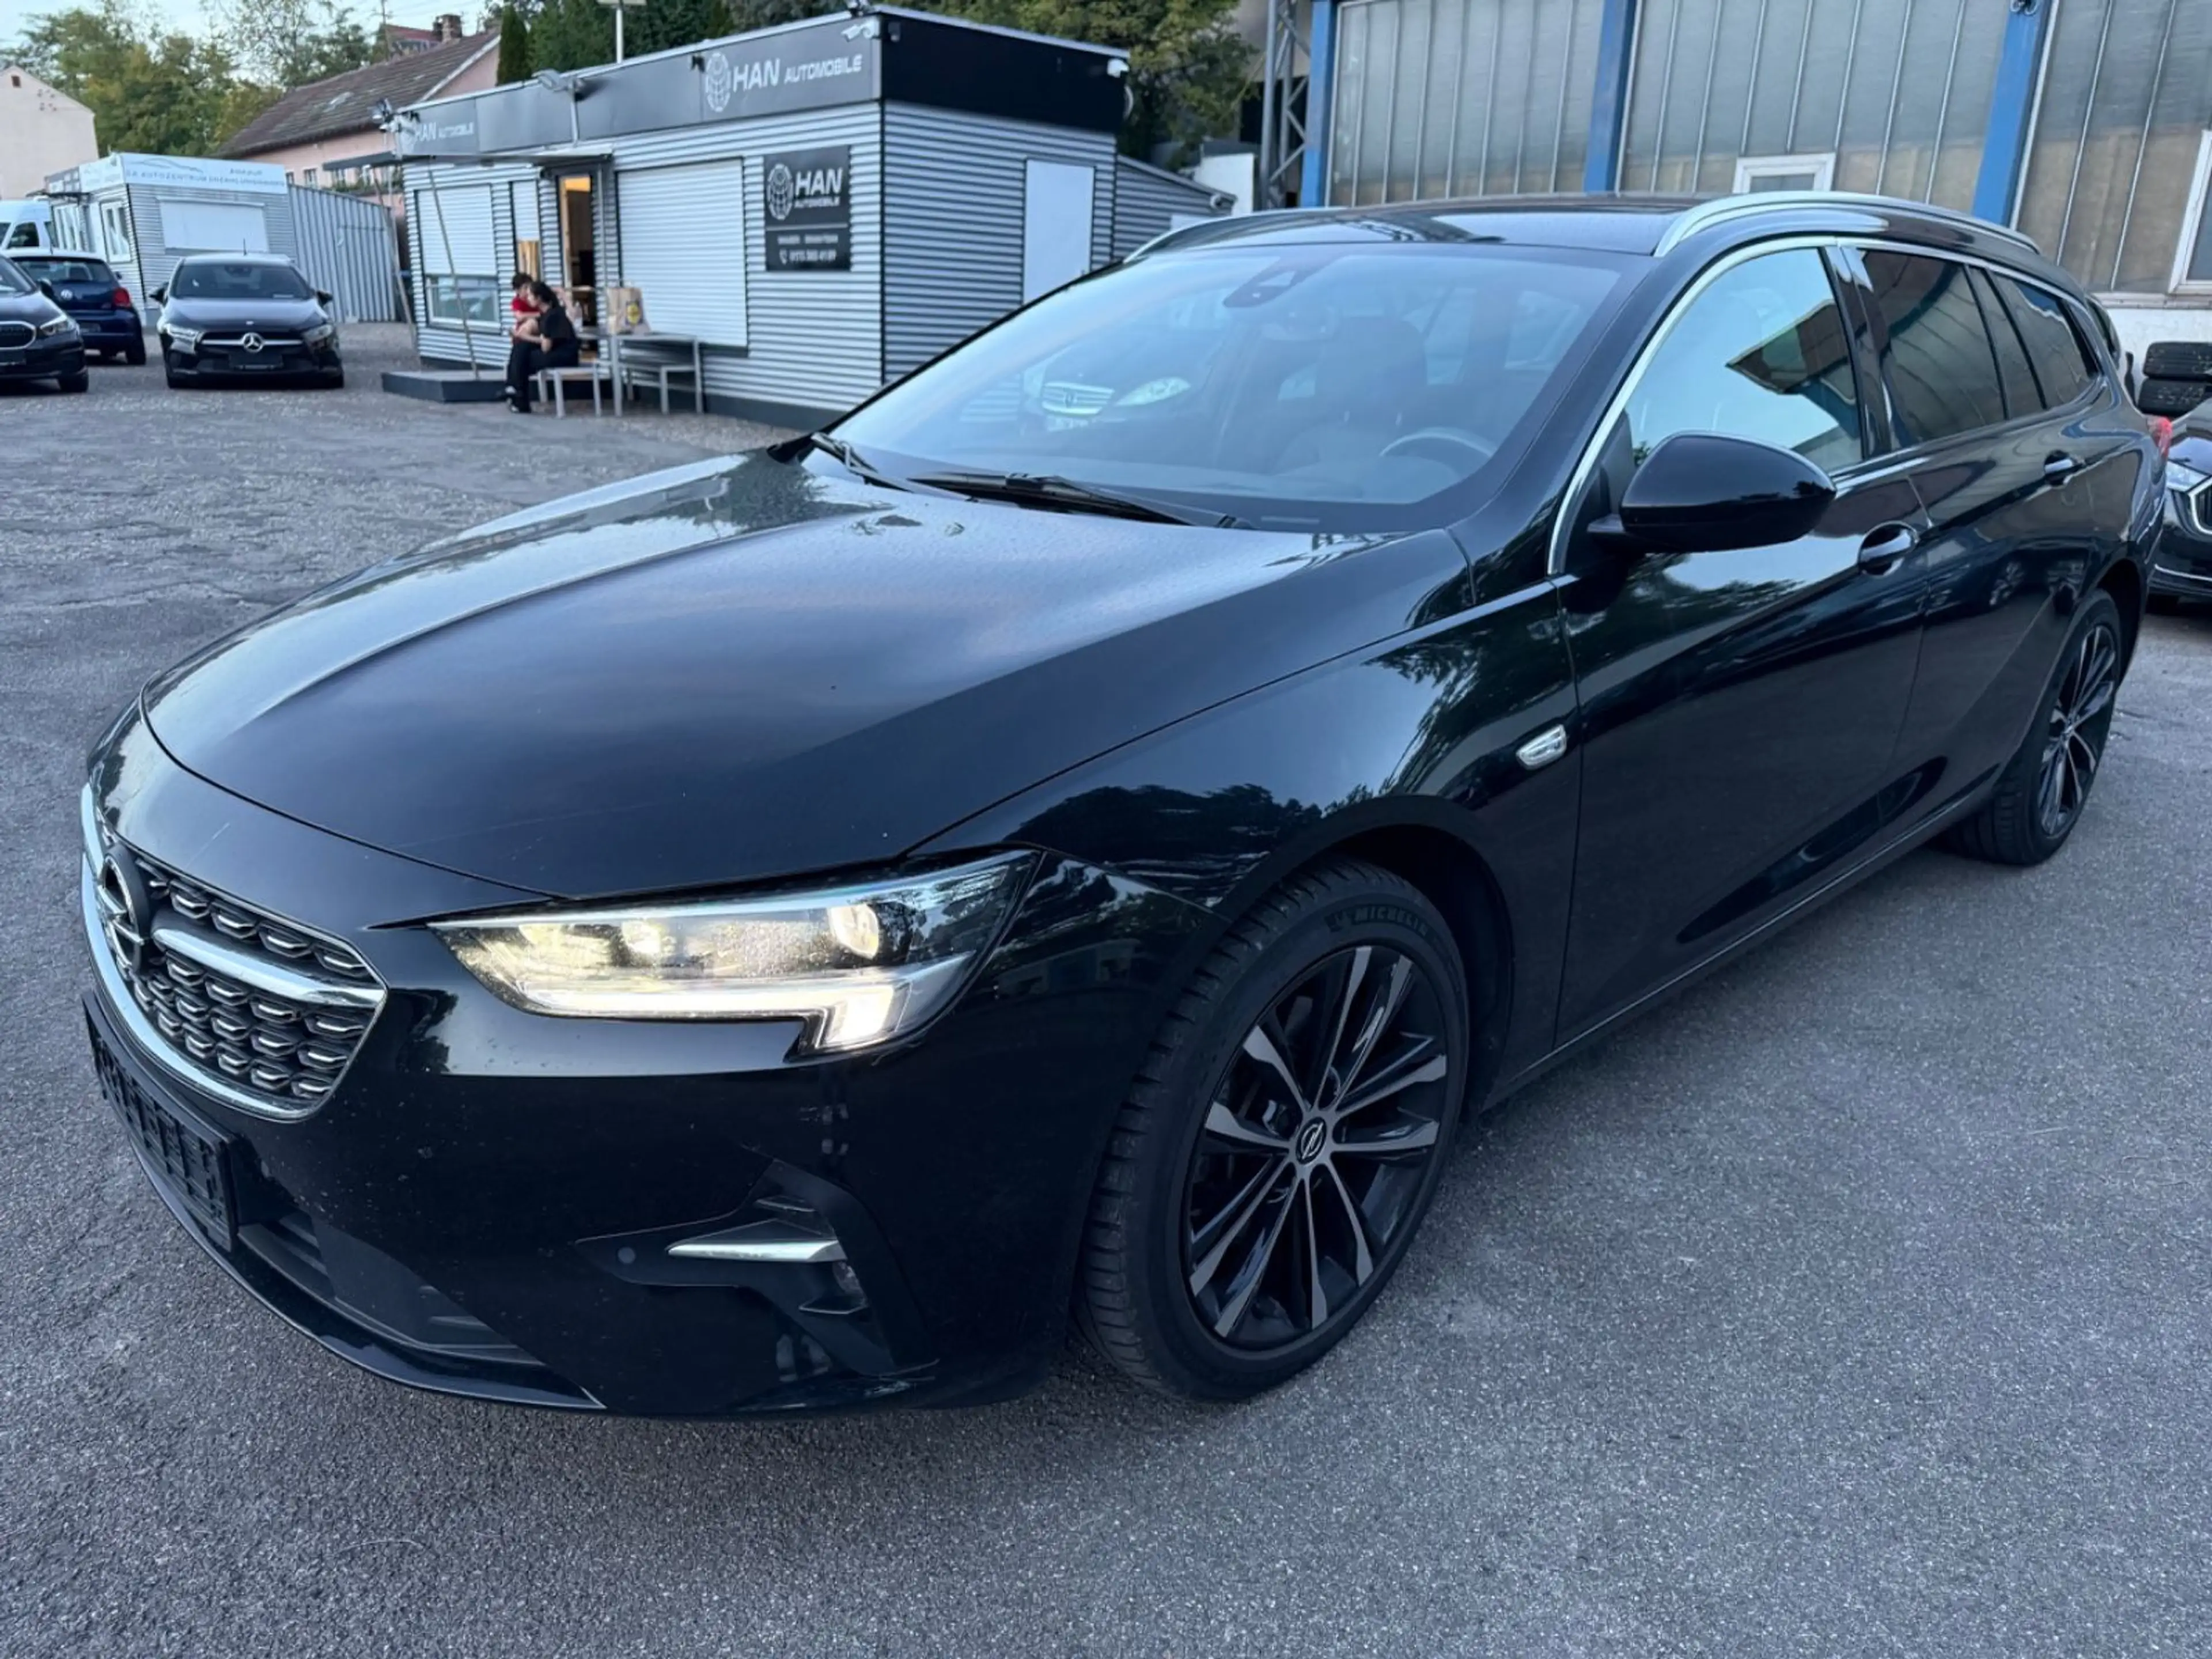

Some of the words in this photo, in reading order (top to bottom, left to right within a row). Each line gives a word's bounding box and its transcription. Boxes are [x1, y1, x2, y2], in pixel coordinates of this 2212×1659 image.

[733, 59, 780, 92] HAN
[784, 54, 862, 83] AUTOMOBILE
[794, 167, 843, 196] HAN
[1355, 906, 1429, 937] MICHELIN
